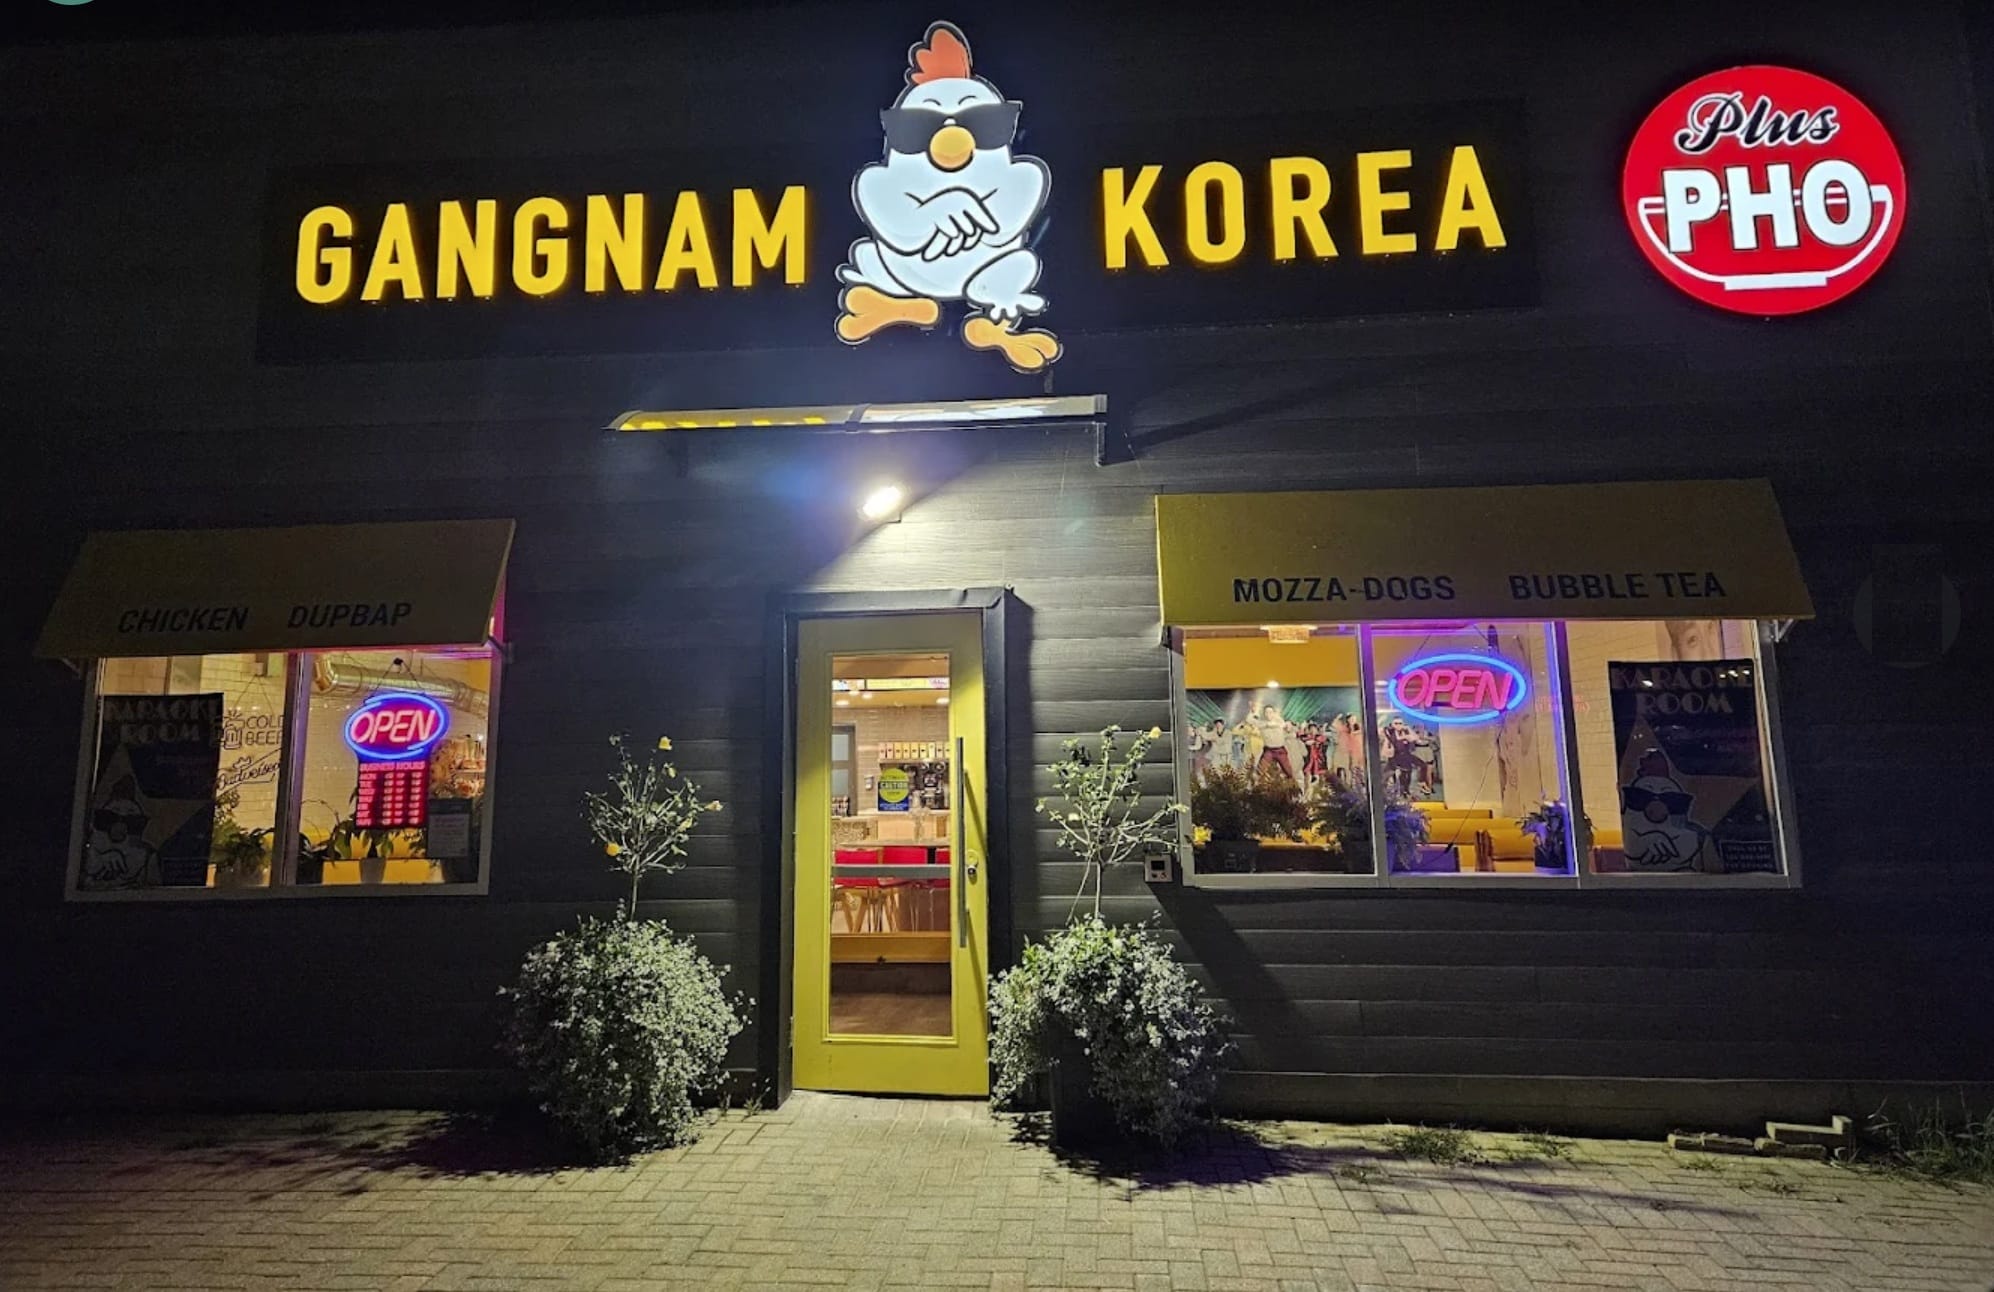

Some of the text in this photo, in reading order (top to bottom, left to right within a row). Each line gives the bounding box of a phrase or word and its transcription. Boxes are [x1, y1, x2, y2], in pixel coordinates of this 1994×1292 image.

[1674, 91, 1840, 155] Plus
[1662, 159, 1873, 253] PHO
[296, 145, 1507, 303] GANGNAM KOREA
[1233, 575, 1456, 603] MOZZA-DOGS
[1508, 571, 1726, 601] BUBBLE TEA
[118, 606, 249, 633] CHICKEN
[287, 602, 412, 629] DUPBAP
[1400, 669, 1513, 711] OPEN
[1635, 692, 1734, 715] ROOM
[350, 709, 436, 744] OPEN
